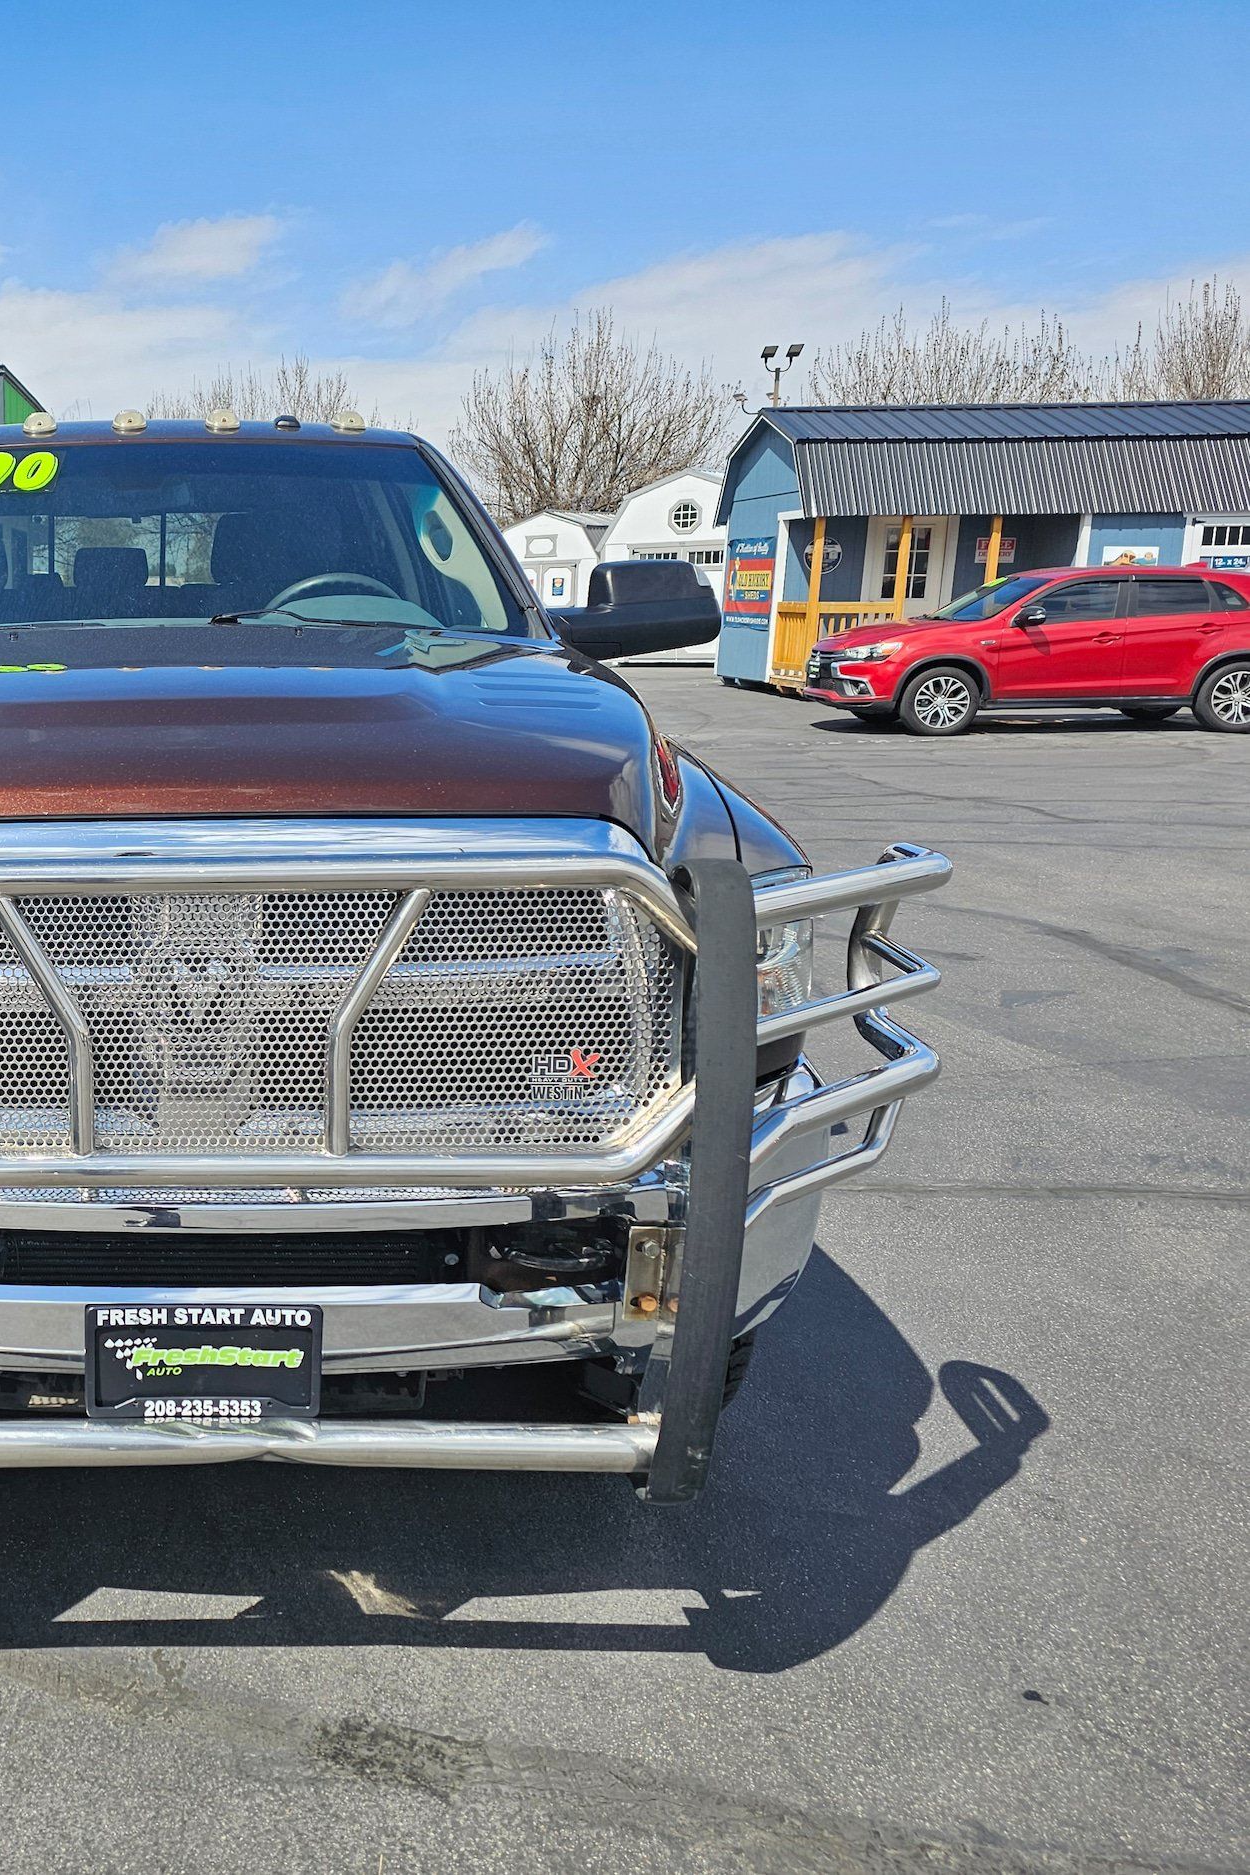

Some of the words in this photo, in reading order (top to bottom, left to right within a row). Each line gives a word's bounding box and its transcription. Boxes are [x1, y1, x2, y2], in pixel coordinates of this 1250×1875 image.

[531, 1048, 601, 1078] HDX
[97, 1308, 168, 1326] FRESH
[174, 1308, 245, 1325] START
[250, 1309, 312, 1327] AUTO
[132, 1346, 304, 1368] FreshStart
[146, 1367, 182, 1376] AUTO
[144, 1400, 262, 1417] 208-235-5353
